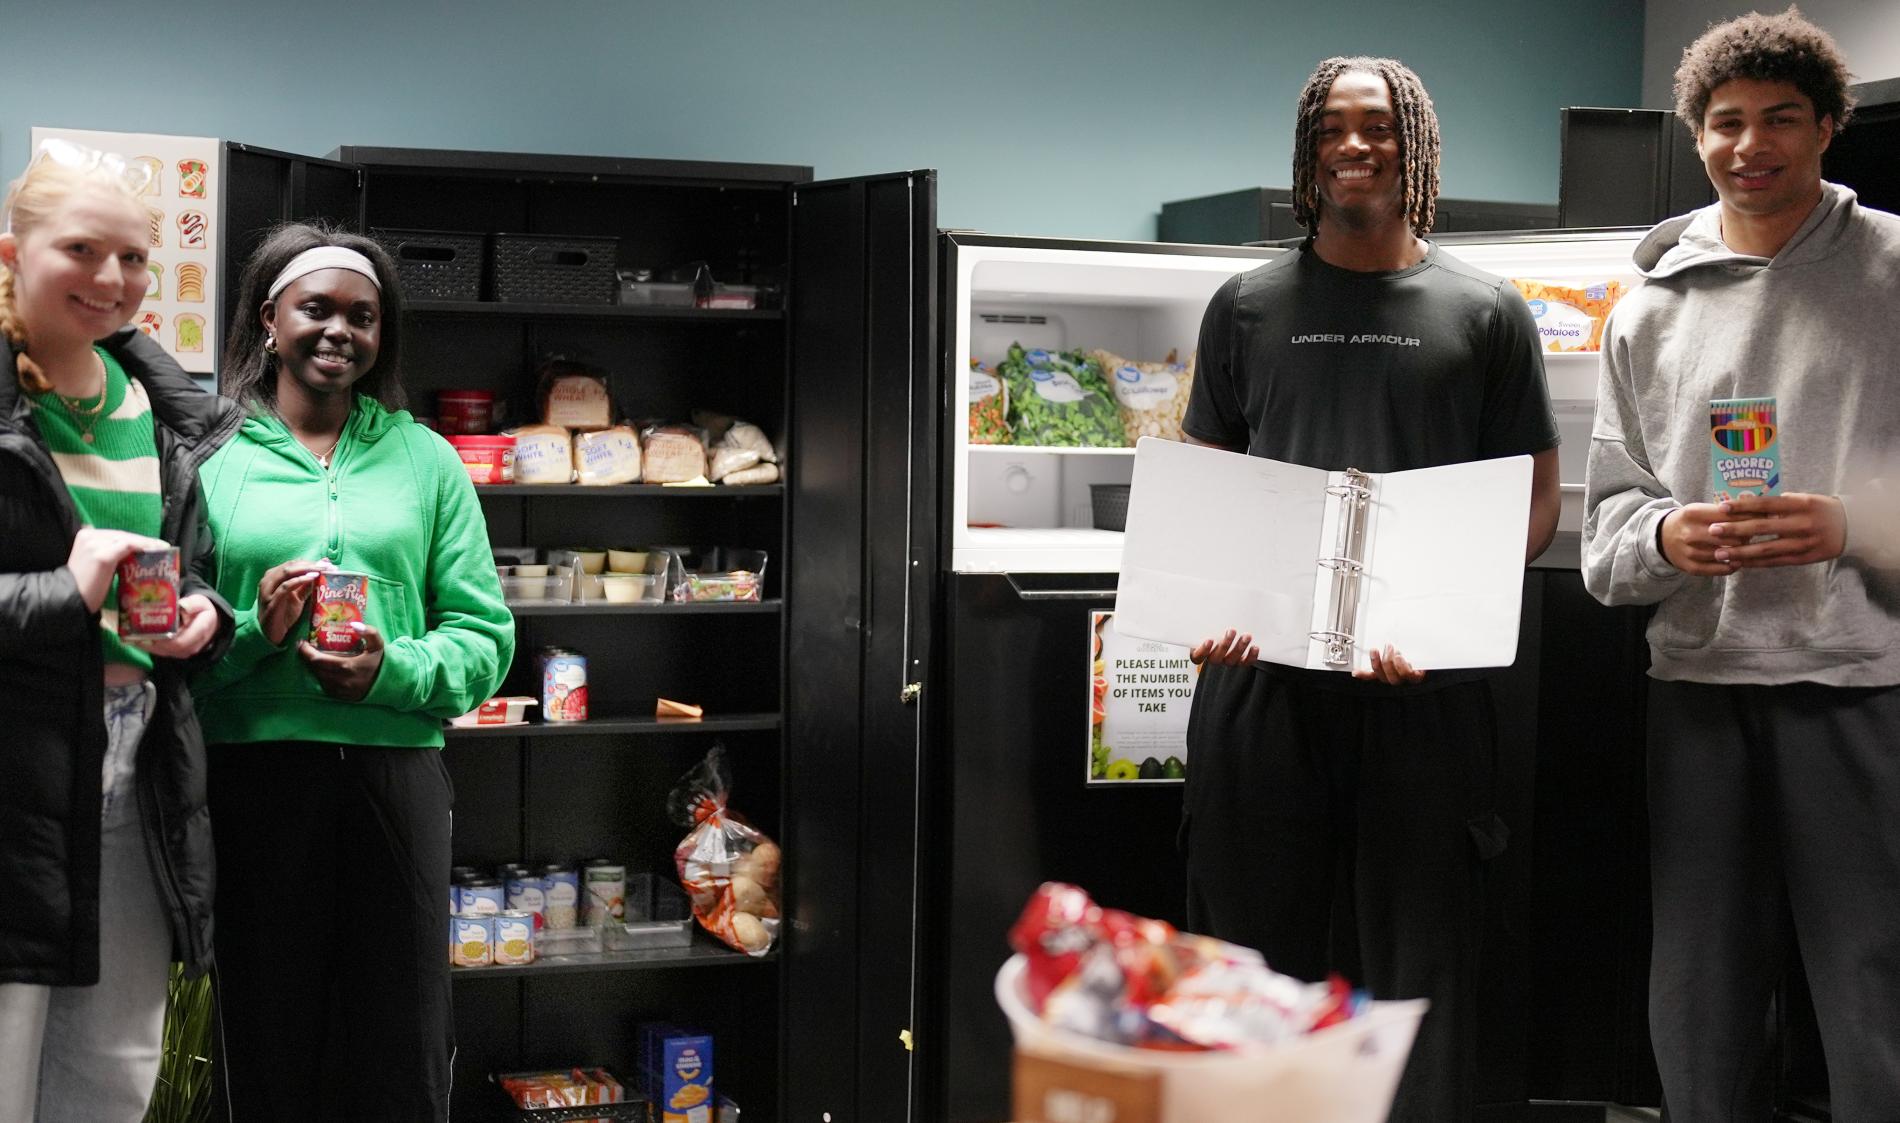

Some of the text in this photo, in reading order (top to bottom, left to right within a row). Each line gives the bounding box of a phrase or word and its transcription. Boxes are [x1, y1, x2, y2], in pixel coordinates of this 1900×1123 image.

[1539, 327, 1580, 337] Potatoes
[1291, 334, 1420, 347] UNDER ARMOUR
[1716, 457, 1774, 472] COLORED
[1722, 467, 1769, 481] PENCILS
[124, 563, 154, 583] Vine
[316, 584, 344, 603] Vine
[140, 613, 168, 625] Sauce
[326, 631, 352, 643] Sauce
[1116, 659, 1189, 669] PLEASE LIMIT
[1116, 674, 1189, 684] THE NUMBER
[1113, 688, 1191, 698] OF ITEMS YOU
[1138, 703, 1166, 713] TAKE
